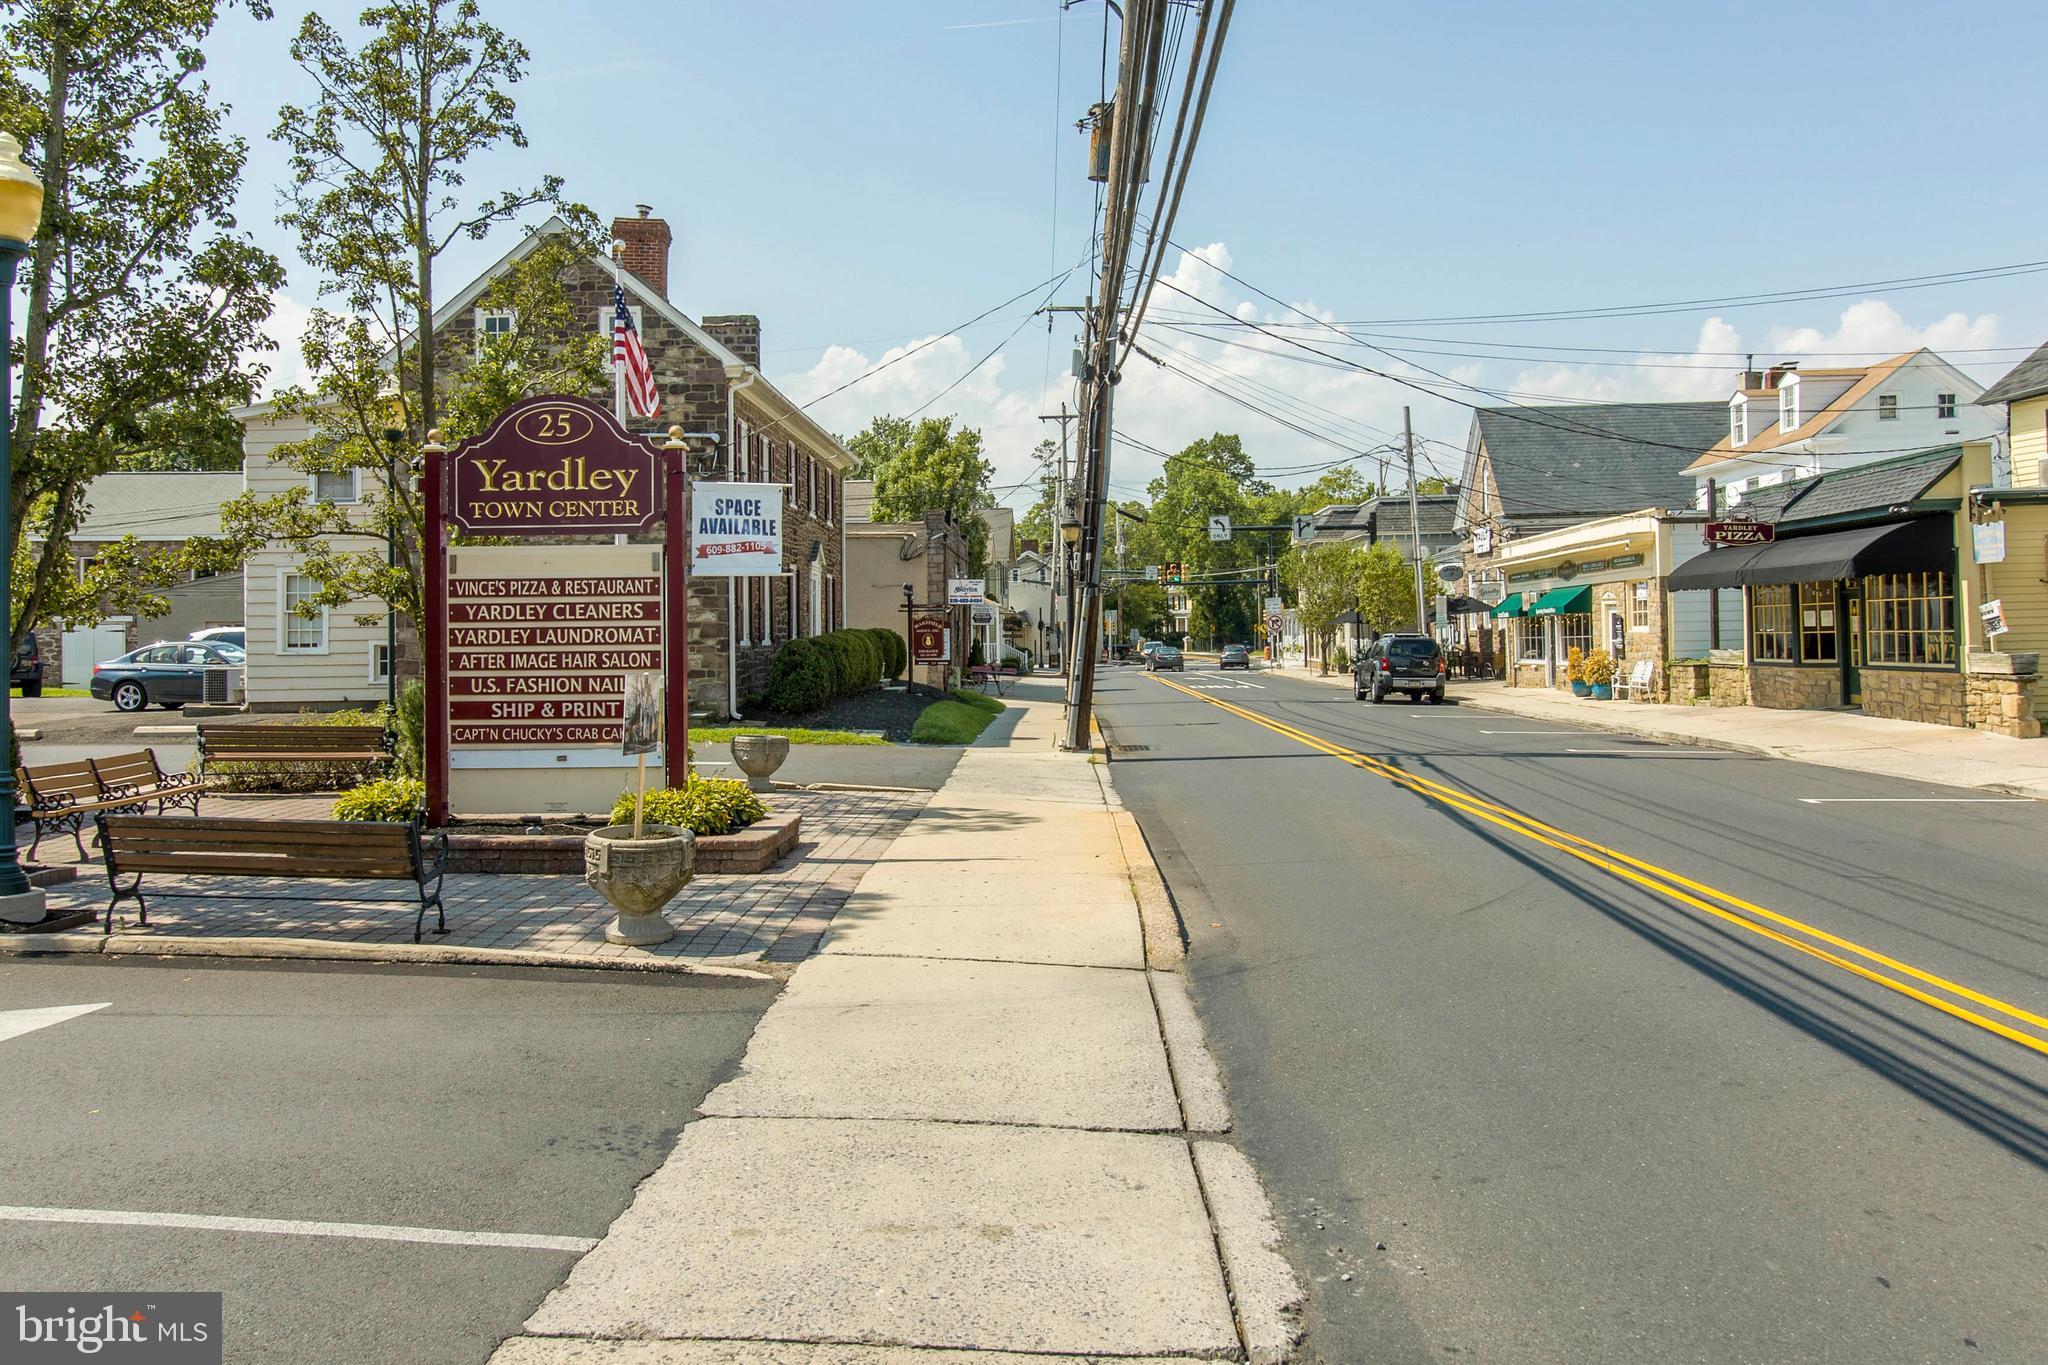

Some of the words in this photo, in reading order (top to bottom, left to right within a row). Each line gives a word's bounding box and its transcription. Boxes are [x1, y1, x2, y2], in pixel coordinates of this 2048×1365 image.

[538, 412, 571, 437] 25
[471, 456, 639, 497] Yardley
[469, 501, 543, 518] TOWN
[549, 500, 640, 517] CENTER
[715, 498, 761, 516] SPACE
[699, 518, 776, 536] AVAILABLE
[1715, 531, 1766, 540] PIZZA
[706, 541, 766, 554] 609-882-1105
[455, 580, 506, 596] VINCE'S
[510, 580, 548, 595] PIZZA
[551, 580, 561, 595] &
[565, 579, 653, 595] RESTAURANT
[465, 604, 547, 620] YARDLEY
[552, 603, 643, 619] CLEANERS
[454, 629, 530, 645] YARDLEY
[536, 627, 656, 644] LAUNDROMAT
[459, 654, 506, 669] AFTER
[510, 653, 557, 669] IMAGE
[562, 653, 598, 668] HAIR
[602, 652, 651, 667] SALON
[471, 679, 500, 693] U.S.
[506, 678, 583, 693] FASHION
[491, 703, 535, 718] SHIP
[541, 702, 554, 718] &
[561, 701, 620, 717] PRINT
[455, 728, 499, 741] CAPT'N
[502, 728, 563, 740] CHUCKY'S
[567, 727, 599, 740] CRAB
